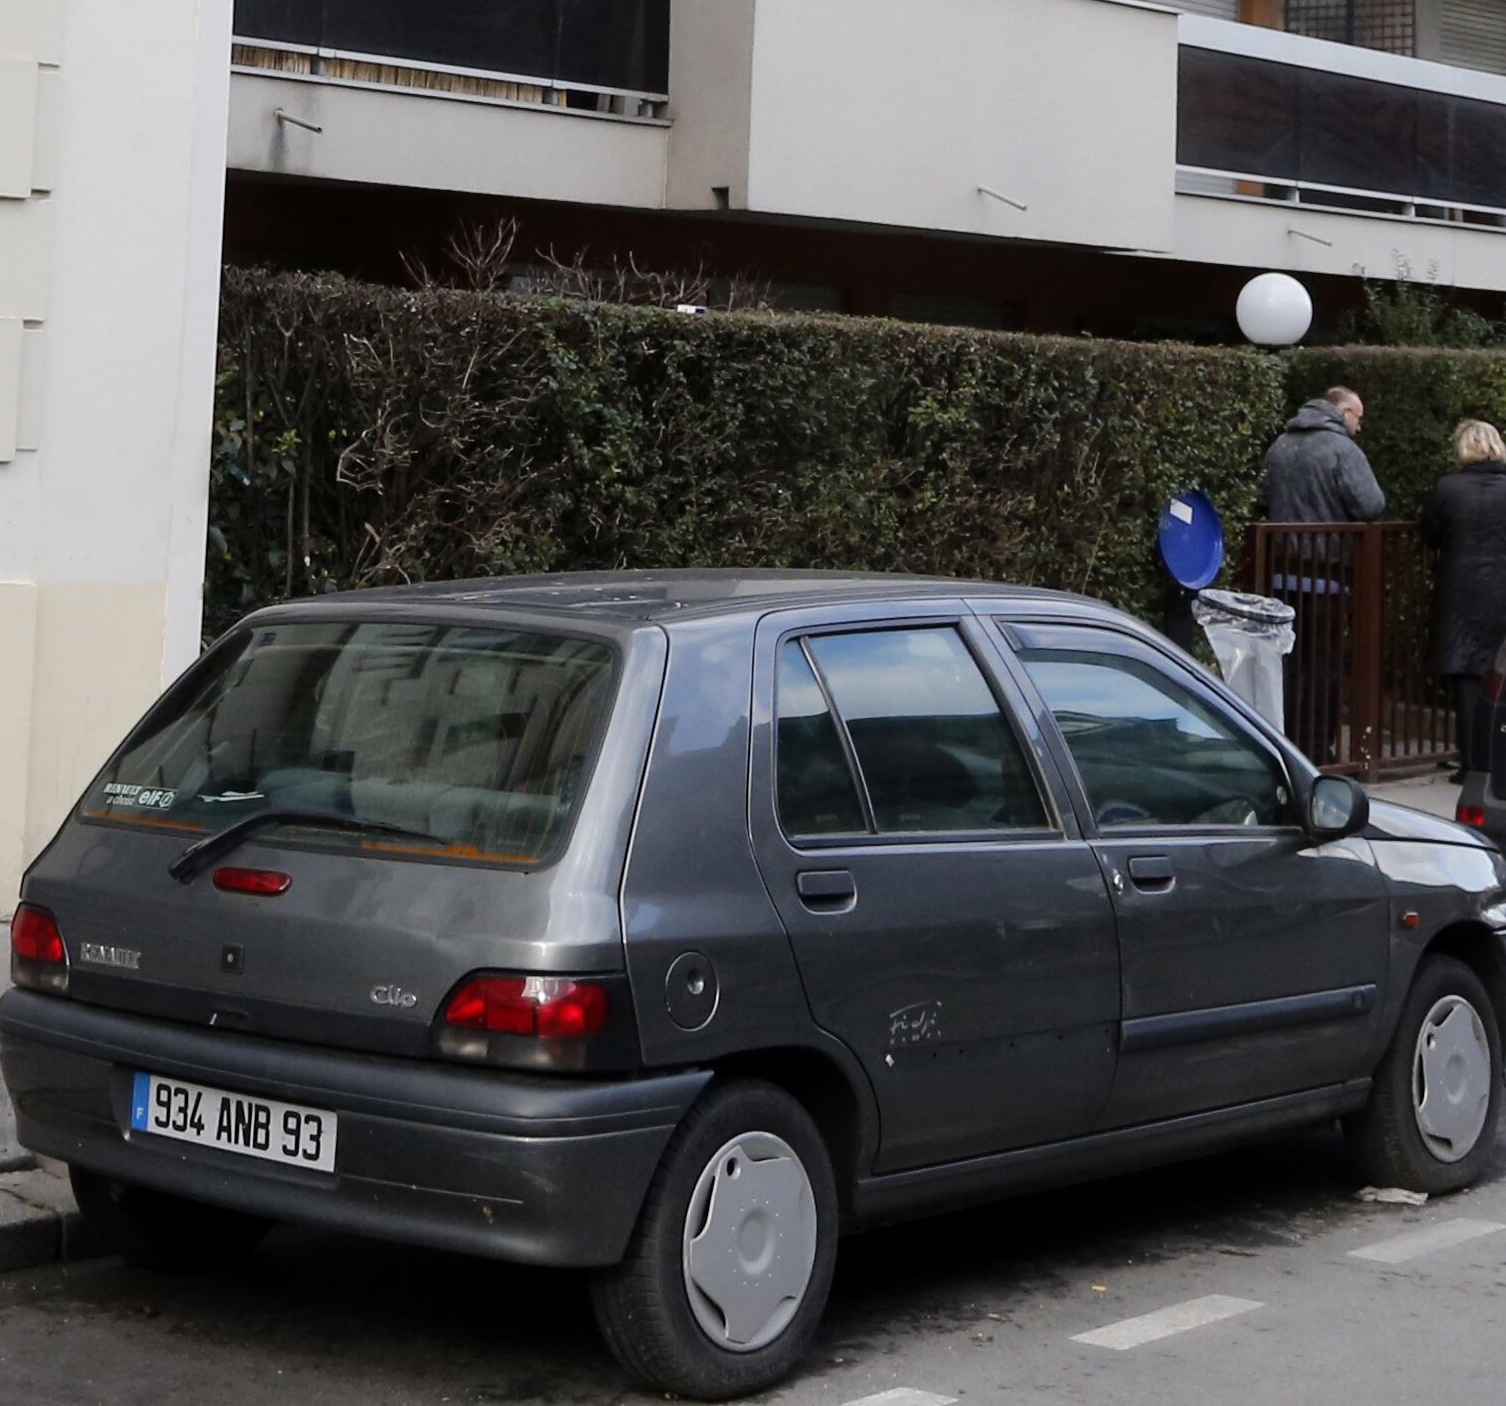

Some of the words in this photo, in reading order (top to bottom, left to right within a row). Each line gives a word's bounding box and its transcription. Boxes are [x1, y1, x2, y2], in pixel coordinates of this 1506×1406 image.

[138, 790, 163, 805] elf
[370, 985, 416, 1007] Clio
[154, 1083, 205, 1136] 934
[216, 1097, 271, 1151] ANB
[282, 1110, 323, 1161] 93
